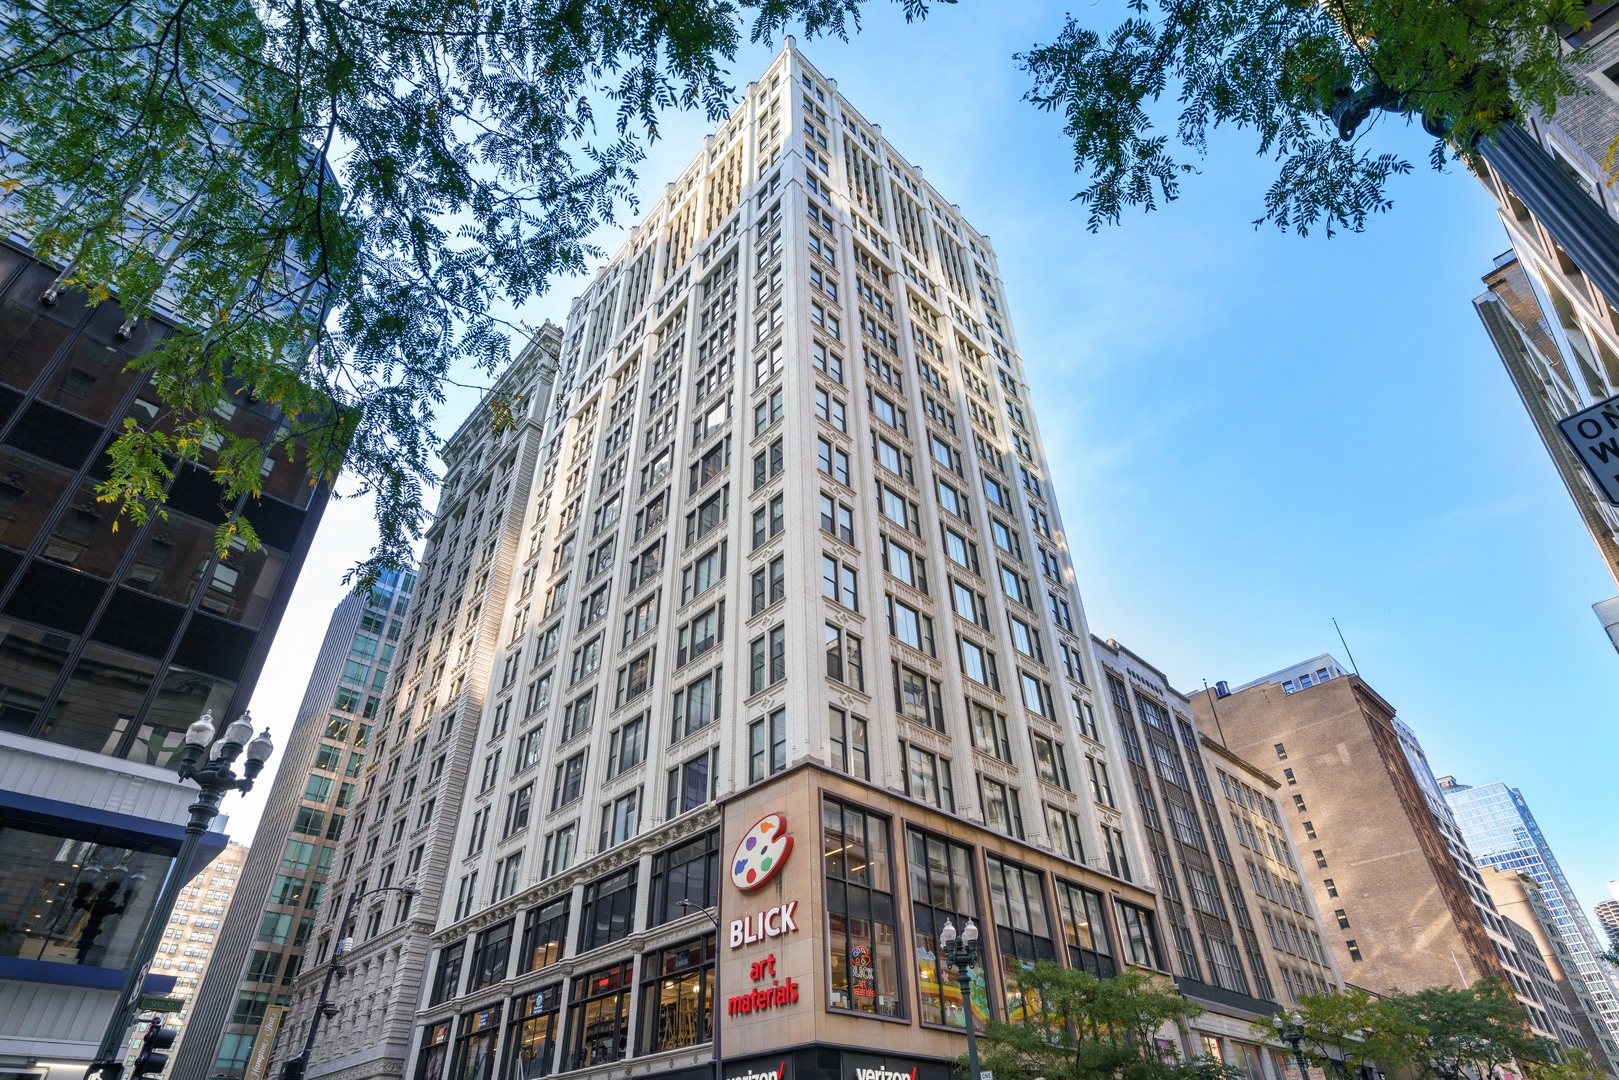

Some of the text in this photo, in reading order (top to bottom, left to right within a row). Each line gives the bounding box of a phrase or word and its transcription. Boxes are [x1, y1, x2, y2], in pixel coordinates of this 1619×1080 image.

[1577, 404, 1619, 440] ON
[730, 900, 798, 950] BLICK
[750, 953, 776, 981] art
[858, 979, 867, 988] art
[728, 977, 799, 1017] materials
[251, 1013, 277, 1080] Hampton Inn
